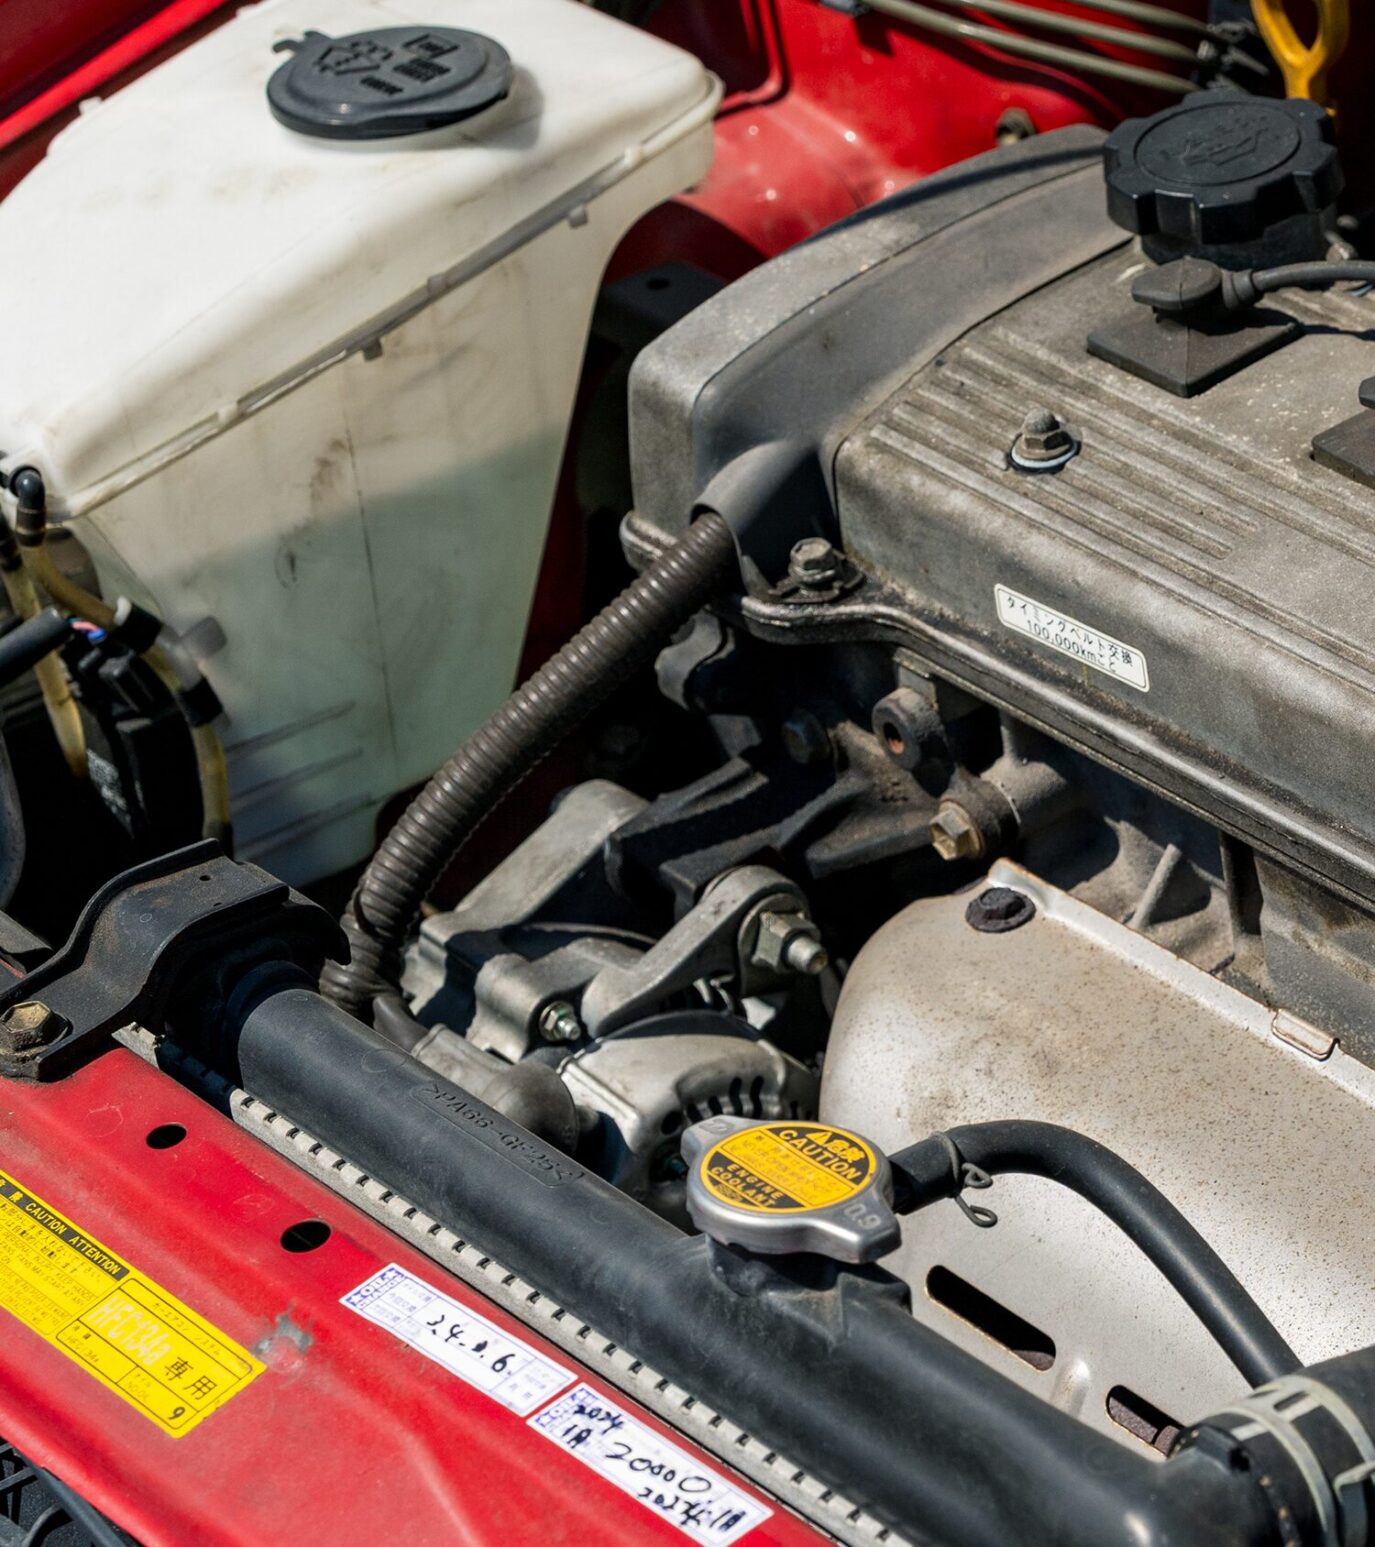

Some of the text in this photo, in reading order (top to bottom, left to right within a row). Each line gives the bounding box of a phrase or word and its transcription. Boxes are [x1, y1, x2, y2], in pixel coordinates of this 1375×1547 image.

[1007, 596, 1133, 667] タイミングベルト交換
[778, 1129, 863, 1181] CAUTION
[711, 1166, 776, 1208] COOLANT
[726, 1163, 784, 1200] ENGINE
[844, 1202, 882, 1231] 0.9
[25, 1202, 68, 1235] CAUTION
[68, 1237, 122, 1276] ATTENTION
[359, 1274, 387, 1297] OIL
[164, 1356, 218, 1400] 専用
[168, 1406, 186, 1420] 9
